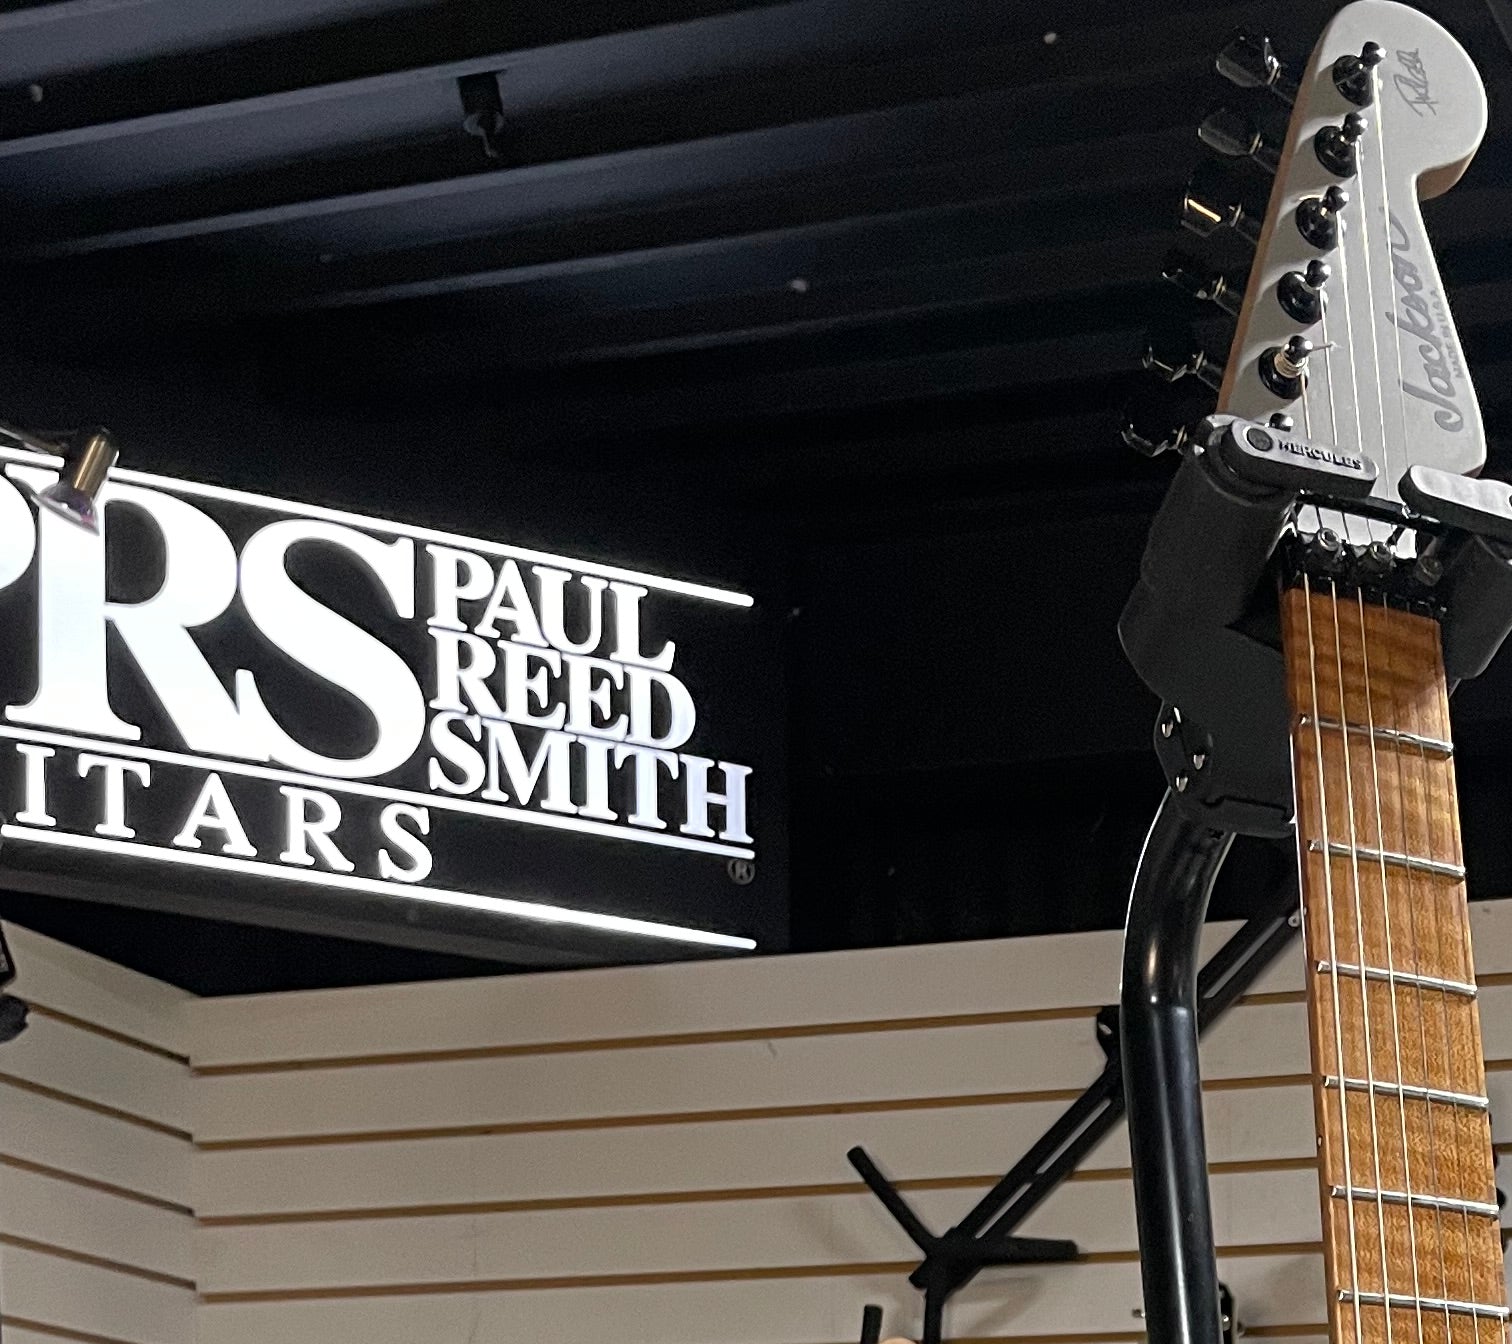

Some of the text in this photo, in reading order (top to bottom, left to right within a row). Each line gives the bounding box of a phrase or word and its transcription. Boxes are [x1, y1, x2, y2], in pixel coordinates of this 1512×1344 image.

[1380, 206, 1463, 432] Jackson
[1278, 440, 1362, 470] HERCULES
[426, 544, 676, 671] PAUL
[429, 627, 696, 751] REED
[428, 711, 754, 844] SMITH
